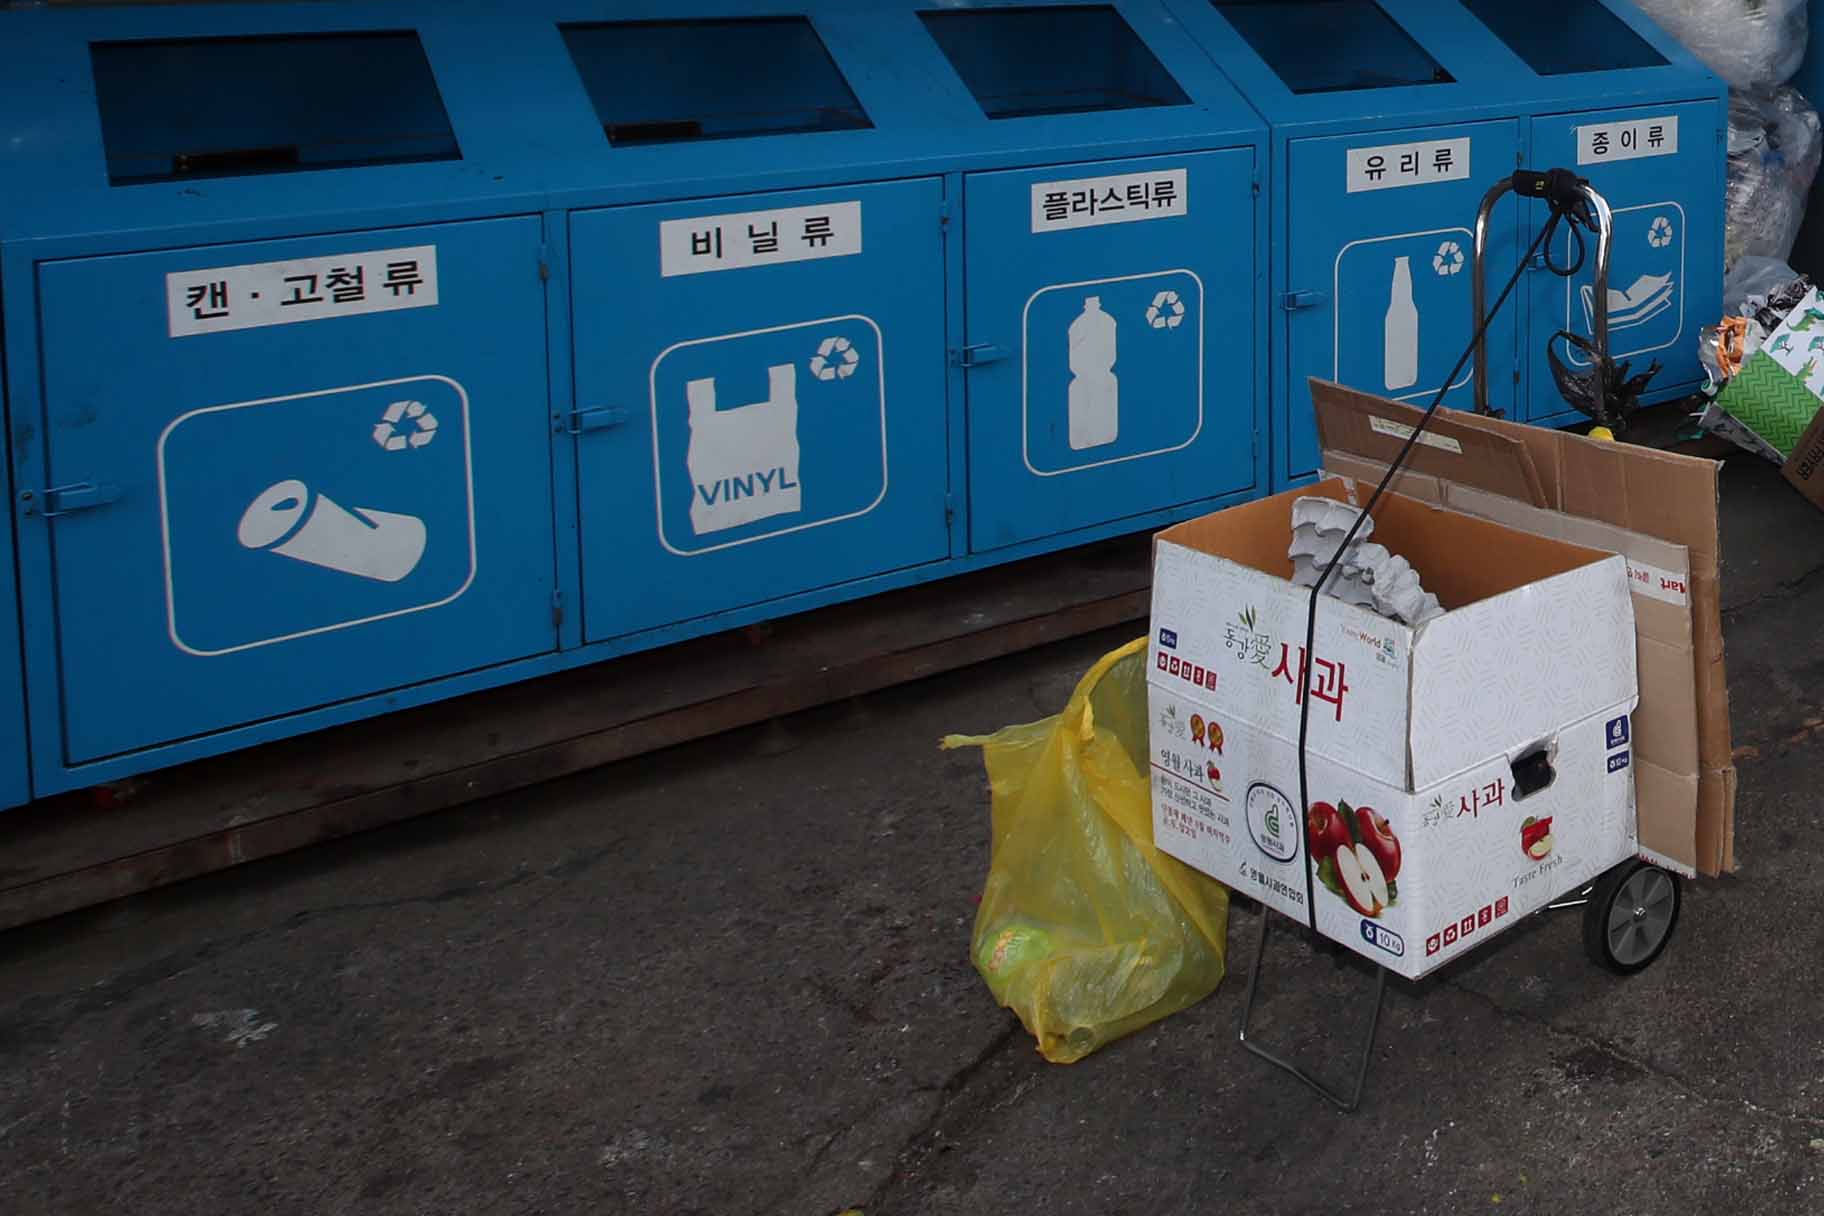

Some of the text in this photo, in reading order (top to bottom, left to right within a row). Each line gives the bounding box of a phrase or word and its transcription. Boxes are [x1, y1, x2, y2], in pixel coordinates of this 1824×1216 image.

[1591, 126, 1667, 156] 종이류
[1364, 147, 1455, 181] 유리류
[1042, 180, 1179, 221] 플라스틱류
[690, 214, 836, 259] 비닐류
[696, 468, 797, 507] VINYL
[1271, 642, 1349, 722] 사과
[1457, 777, 1505, 819] 사과
[1511, 854, 1564, 889] Taste Fresh
